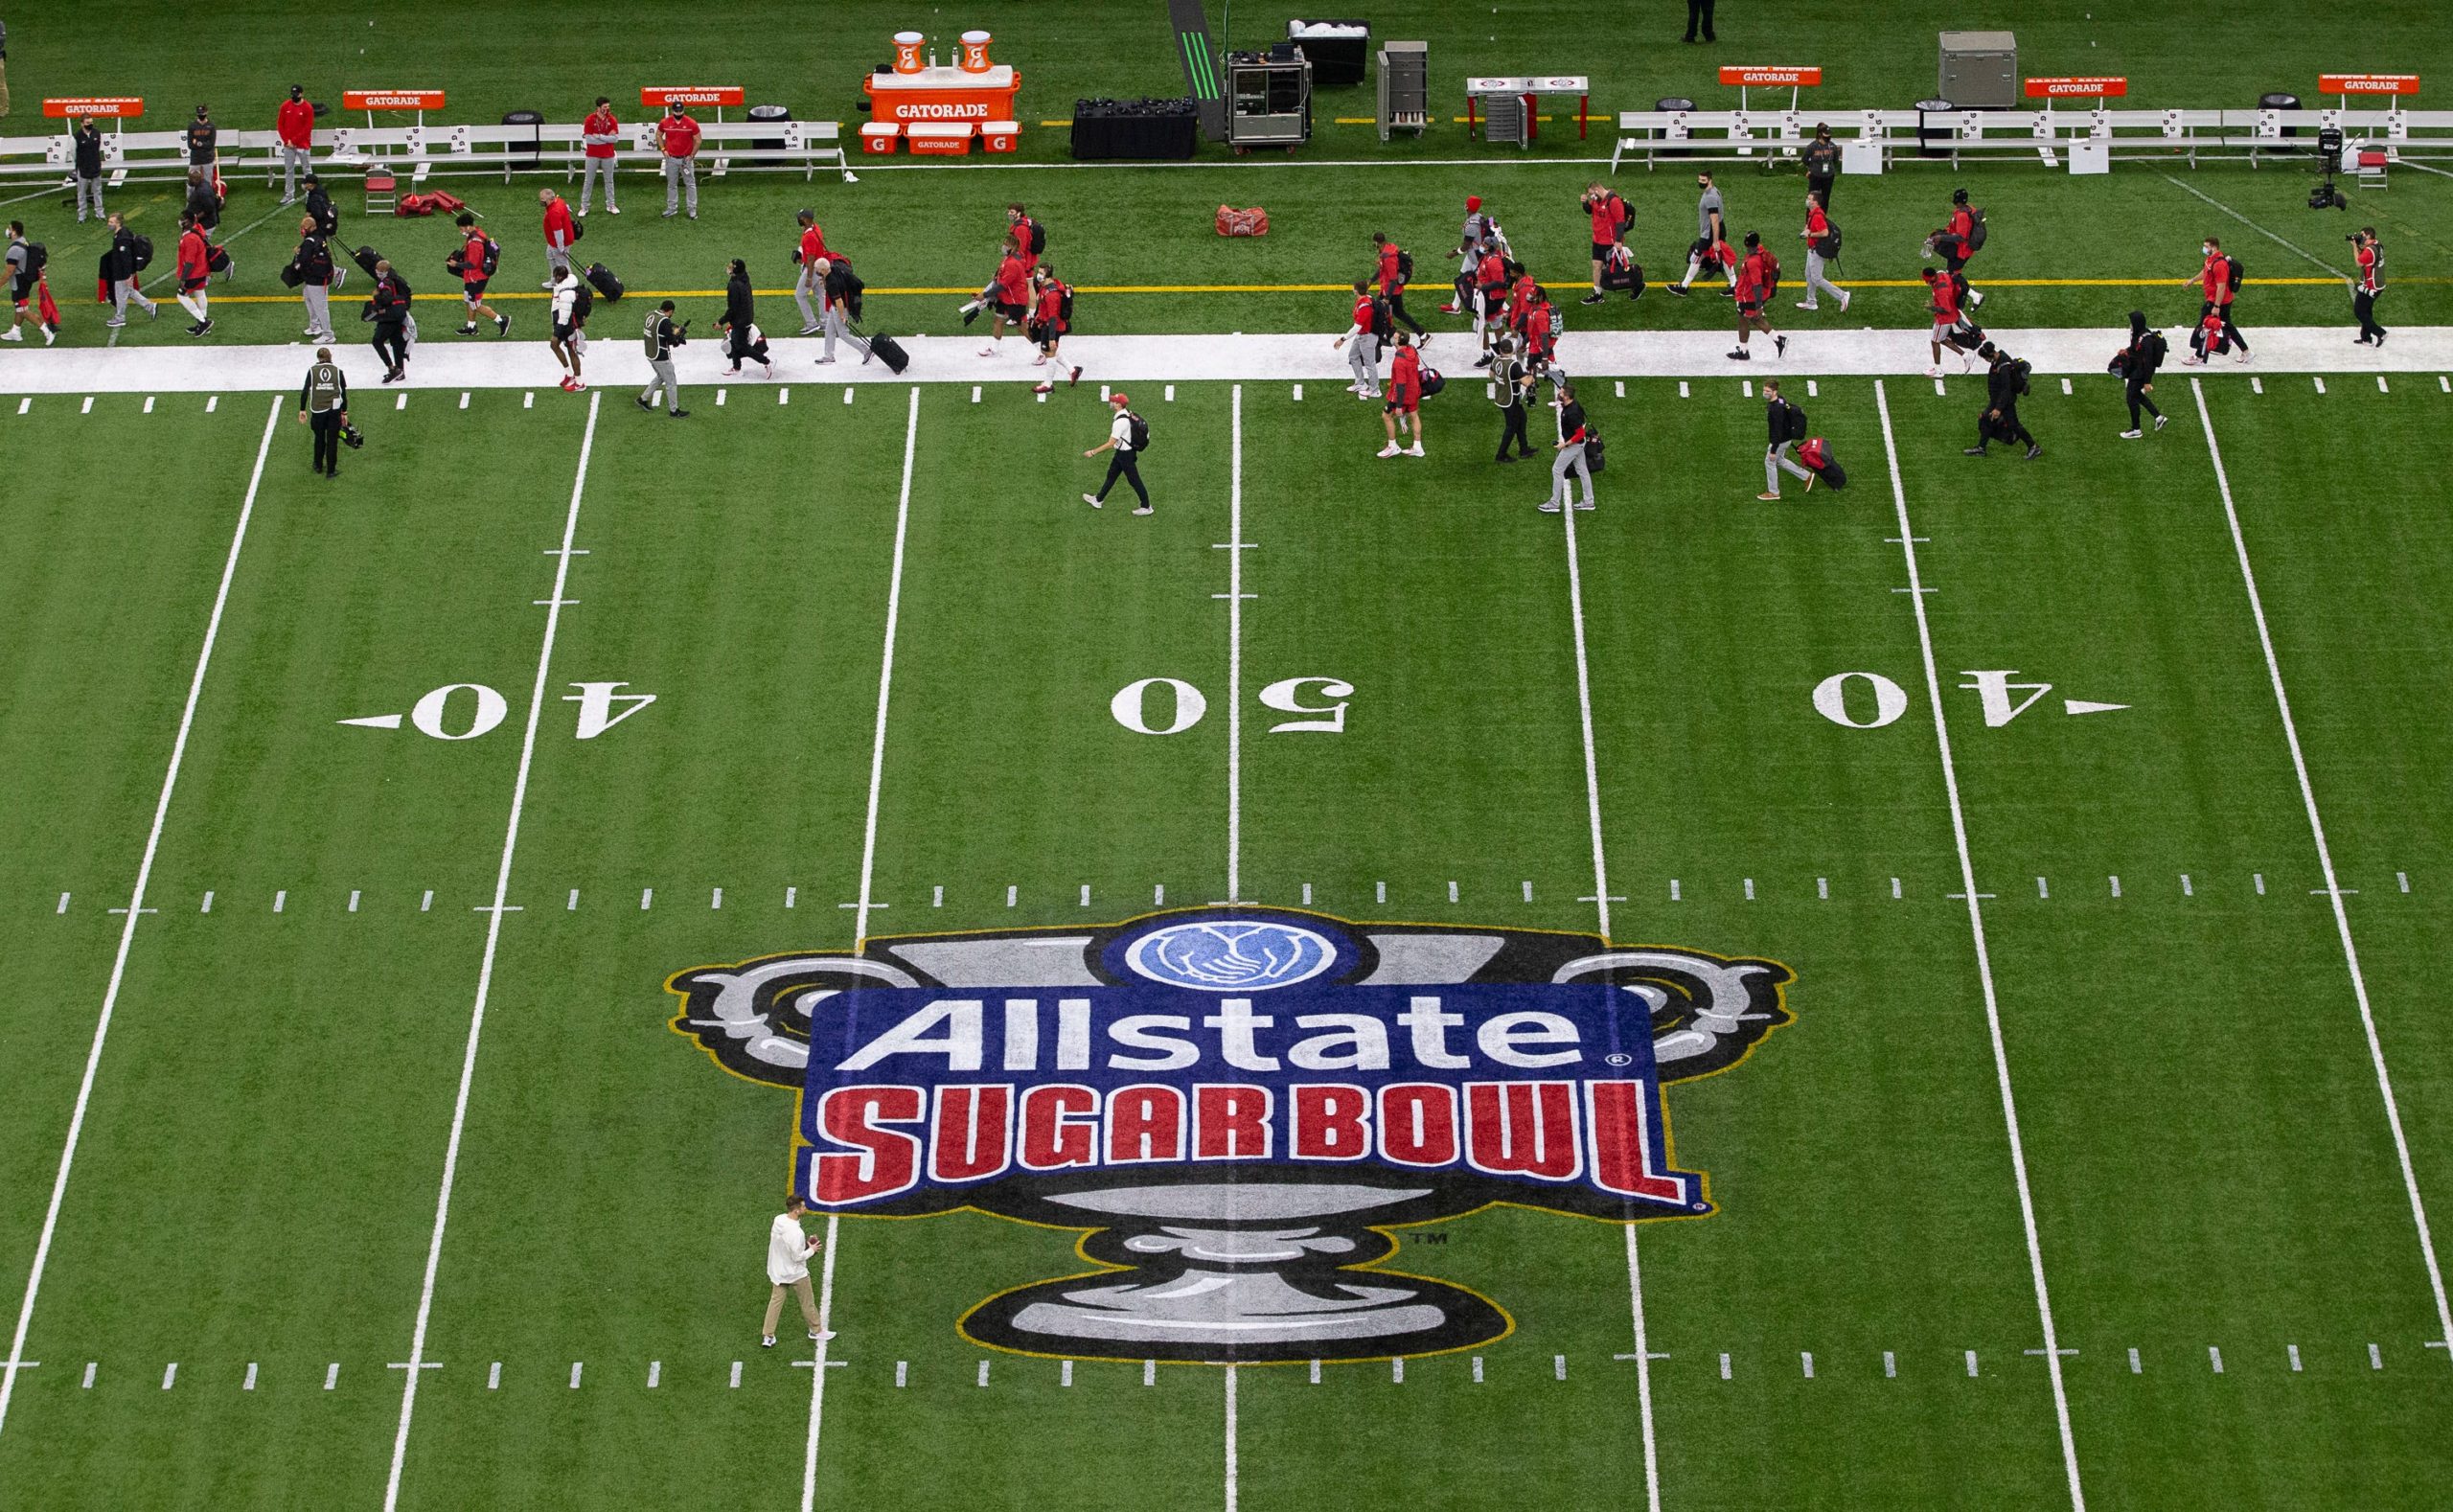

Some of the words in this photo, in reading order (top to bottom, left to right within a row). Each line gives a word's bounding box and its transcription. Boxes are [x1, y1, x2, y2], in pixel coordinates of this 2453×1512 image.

[902, 48, 913, 59] G
[971, 48, 982, 58] G
[1743, 73, 1799, 81] GATORADE
[2048, 83, 2103, 93] GATORADE
[2345, 80, 2399, 90] GATORADE
[365, 97, 421, 105] GATORADE
[664, 93, 721, 103] GATORADE
[65, 104, 120, 113] GATORADE
[896, 103, 988, 118] GATORADE
[872, 138, 885, 151] G
[993, 137, 1006, 149] G
[1110, 676, 1355, 735] 50
[834, 996, 1584, 1072] Allstate
[810, 1082, 1274, 1205] SUGAR
[1288, 1079, 1686, 1205] BOWL
